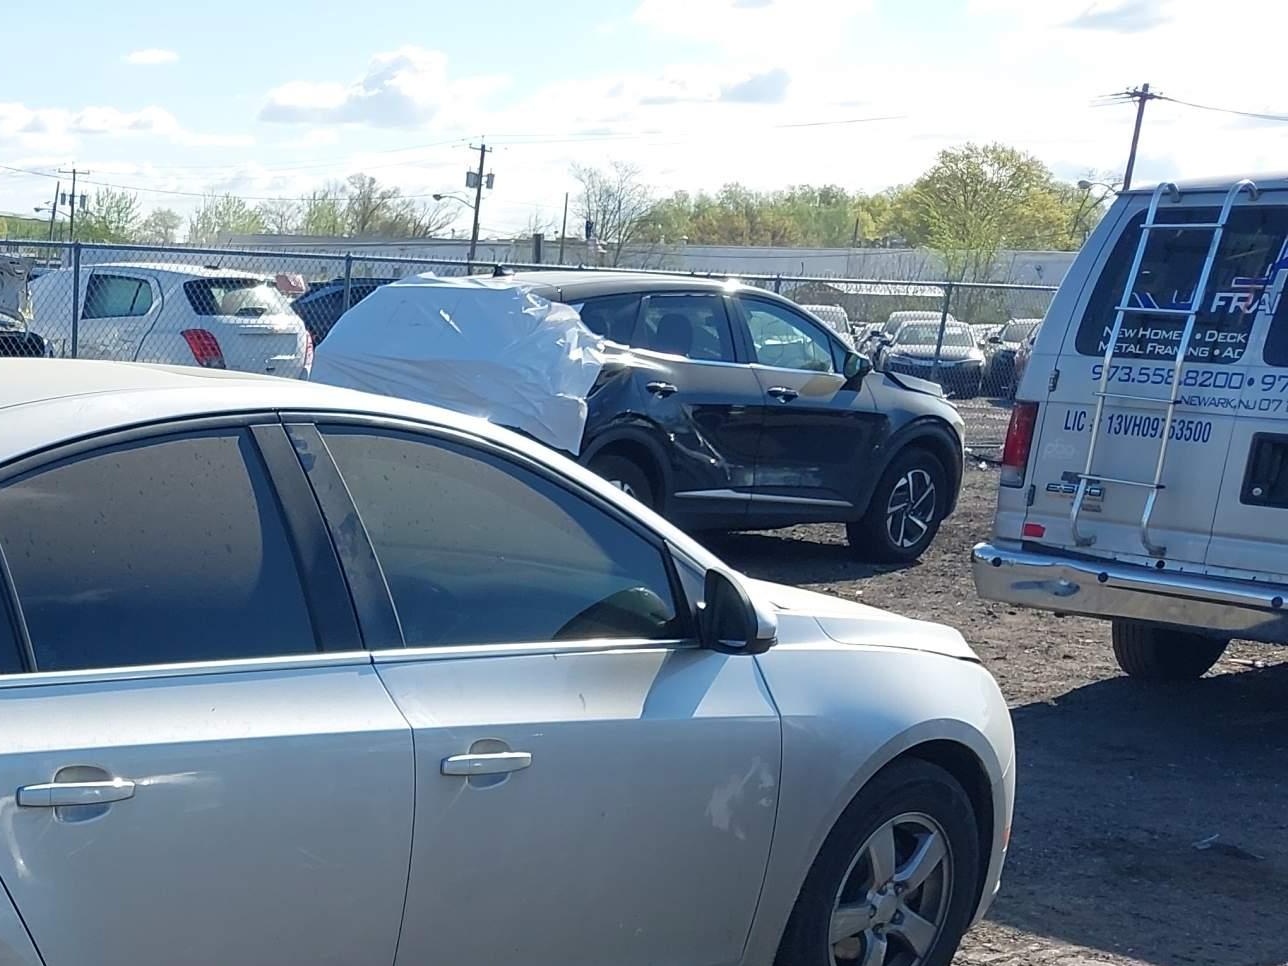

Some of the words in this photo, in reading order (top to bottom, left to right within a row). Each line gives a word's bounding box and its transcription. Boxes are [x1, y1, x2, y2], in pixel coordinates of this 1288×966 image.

[1103, 325, 1137, 339] NEW
[1098, 340, 1144, 354] METAL
[1146, 343, 1210, 357] FRAMNG
[1092, 364, 1244, 390] 973.558.8200
[1064, 409, 1087, 432] LIC
